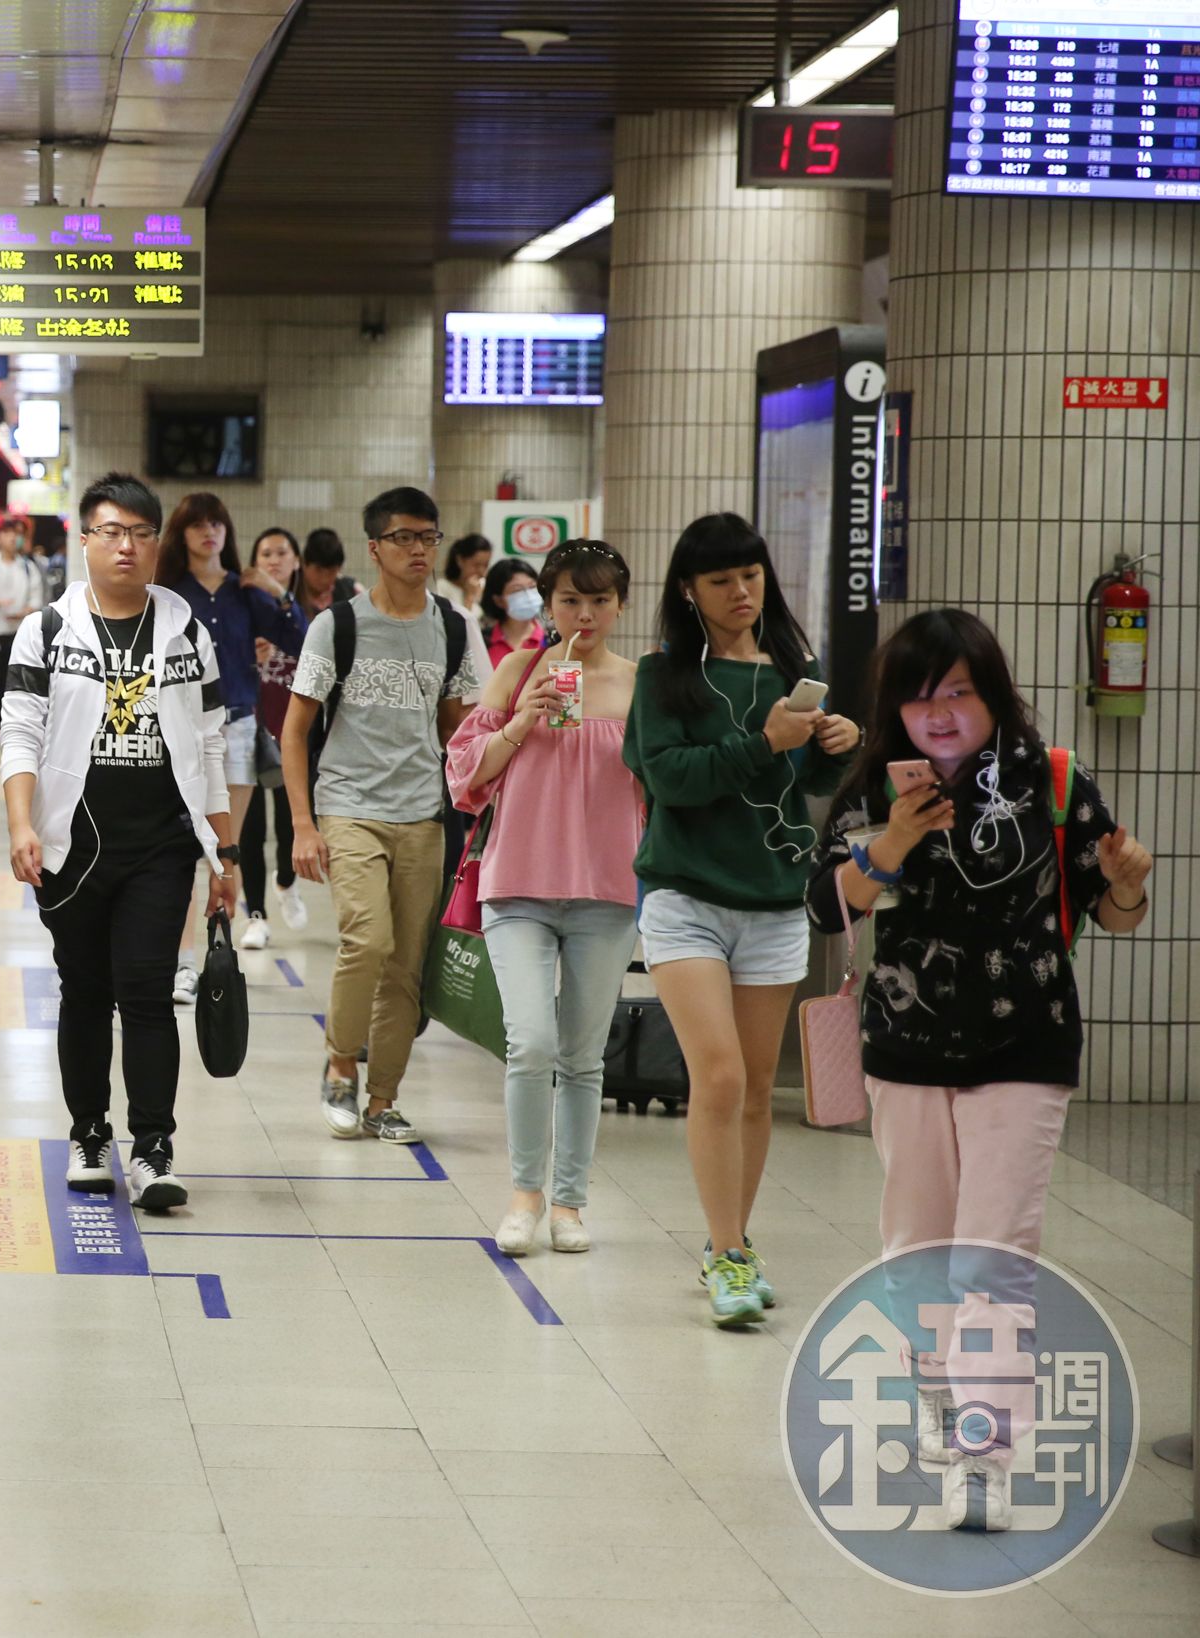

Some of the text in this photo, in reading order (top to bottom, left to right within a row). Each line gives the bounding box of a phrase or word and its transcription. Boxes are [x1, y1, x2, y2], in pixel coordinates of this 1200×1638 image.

[1146, 43, 1160, 55] 1B
[1145, 58, 1159, 70] 1A
[1143, 74, 1158, 85] 1B
[1142, 89, 1157, 101] 1A
[1141, 104, 1156, 116] 1B
[1140, 120, 1155, 131] 1B
[1139, 135, 1154, 147] 1B
[1137, 151, 1153, 163] 1A
[1000, 162, 1031, 174] 16:17
[1136, 166, 1151, 179] 1B
[63, 214, 101, 232] 時間
[133, 232, 192, 246] Remarks
[1083, 380, 1138, 397] 滅火器
[848, 415, 877, 613] Information
[94, 757, 136, 767] ORIGINAL
